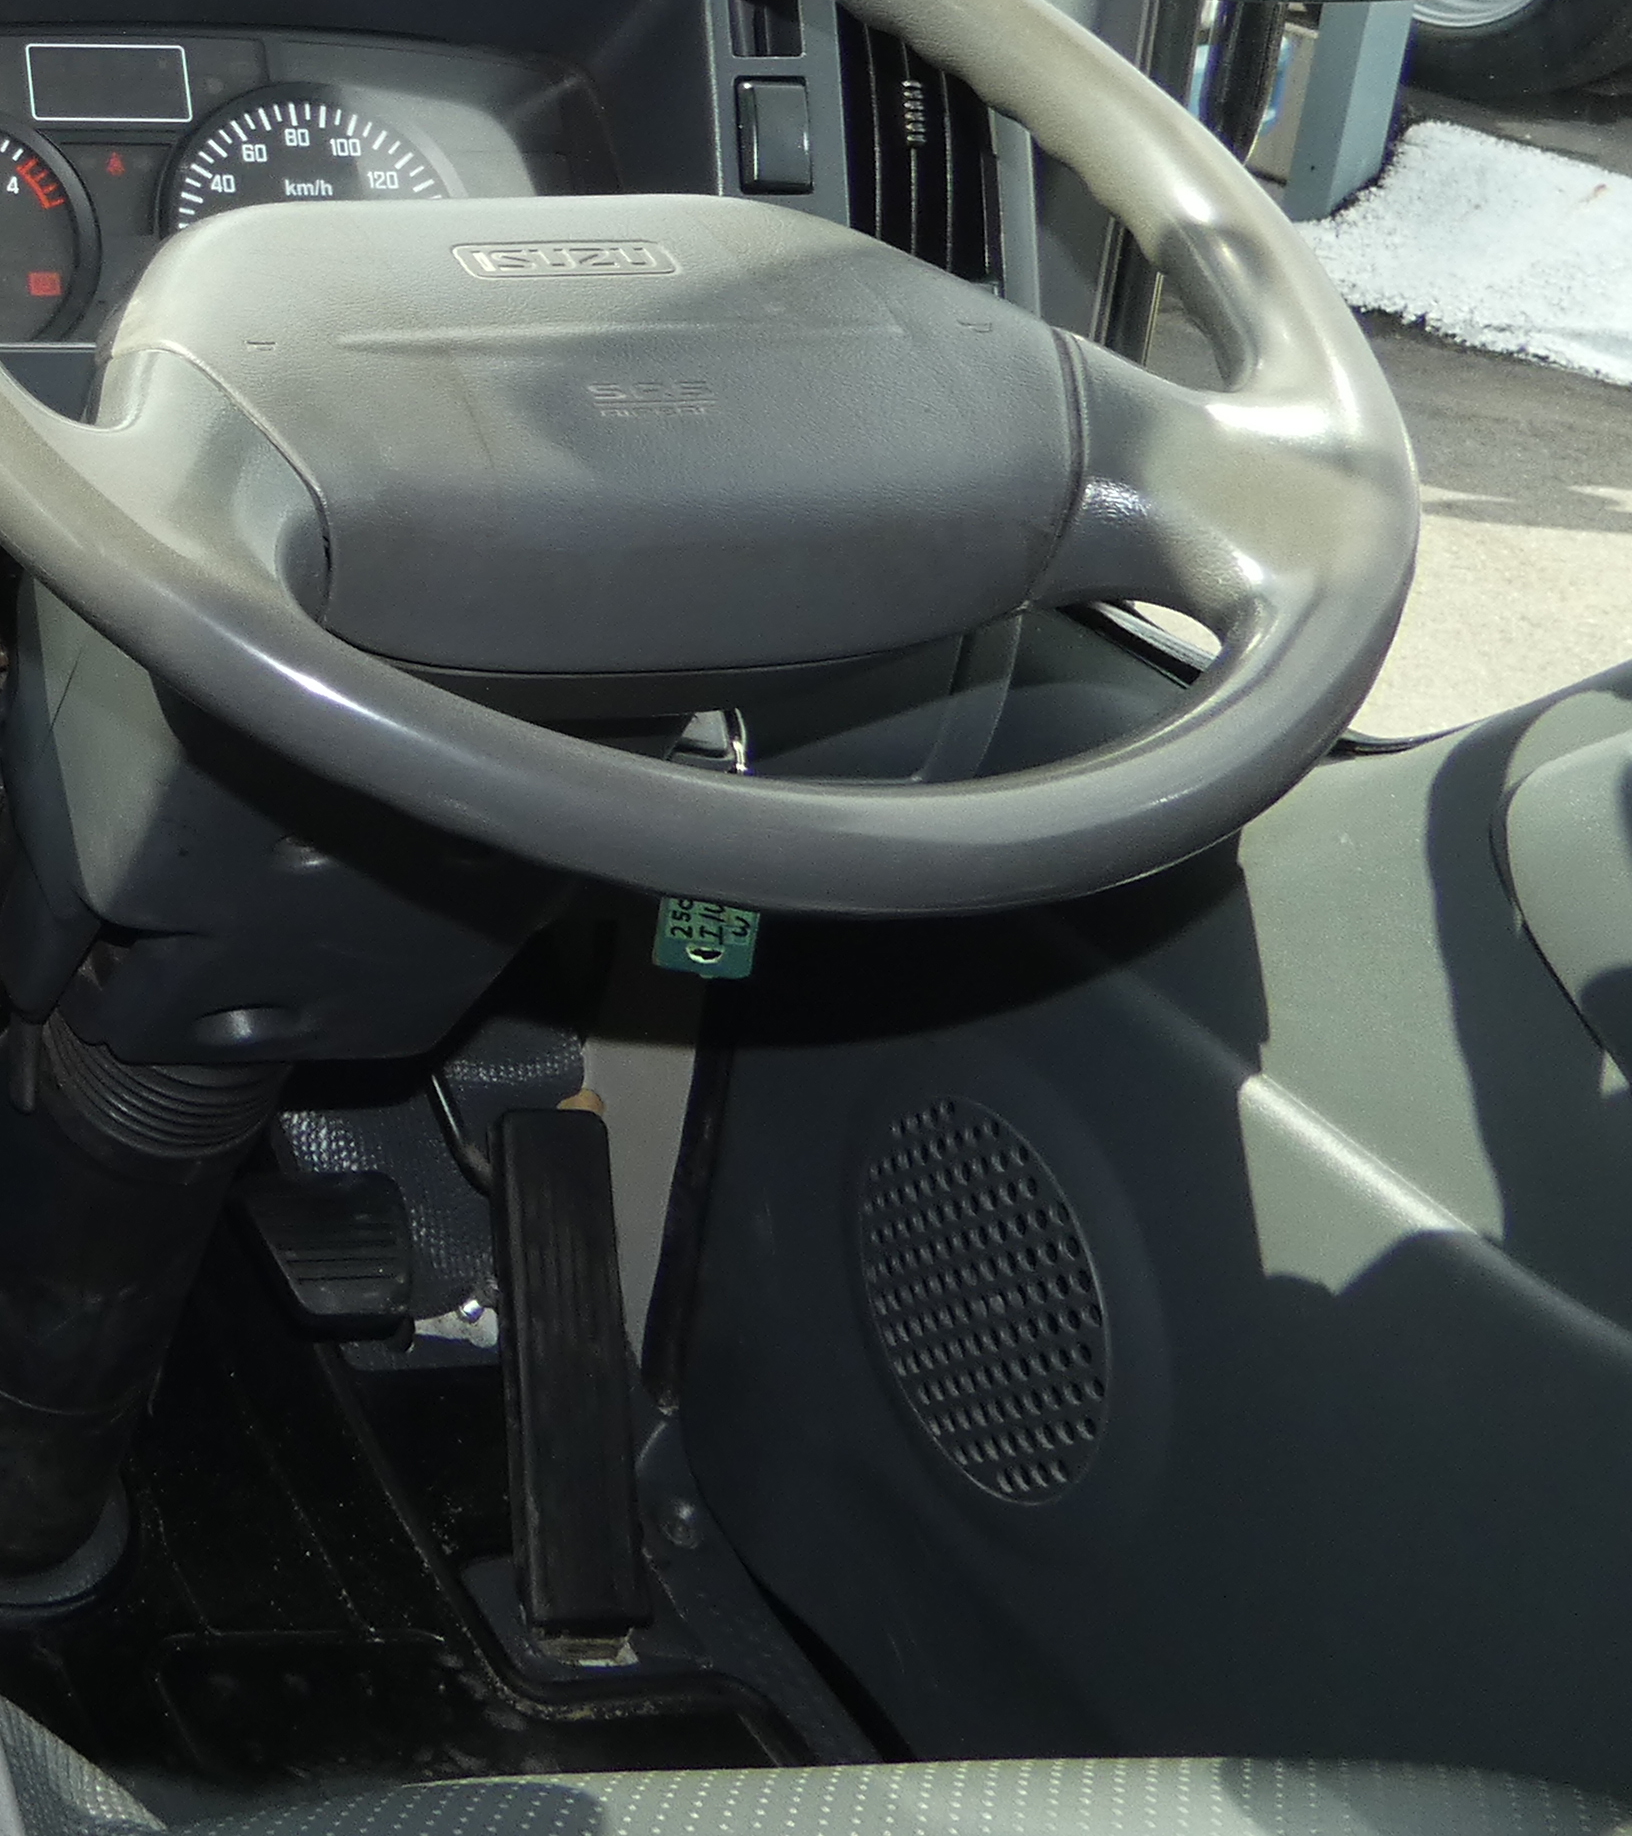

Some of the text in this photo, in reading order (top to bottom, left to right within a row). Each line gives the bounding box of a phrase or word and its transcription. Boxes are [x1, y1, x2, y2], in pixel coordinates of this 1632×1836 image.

[285, 128, 310, 147] 80
[242, 144, 267, 163] 60
[329, 138, 362, 158] 100
[6, 176, 19, 195] 4
[210, 174, 236, 193] 40
[285, 178, 333, 197] km/h
[367, 170, 399, 190] 120
[472, 247, 658, 272] ISUZU
